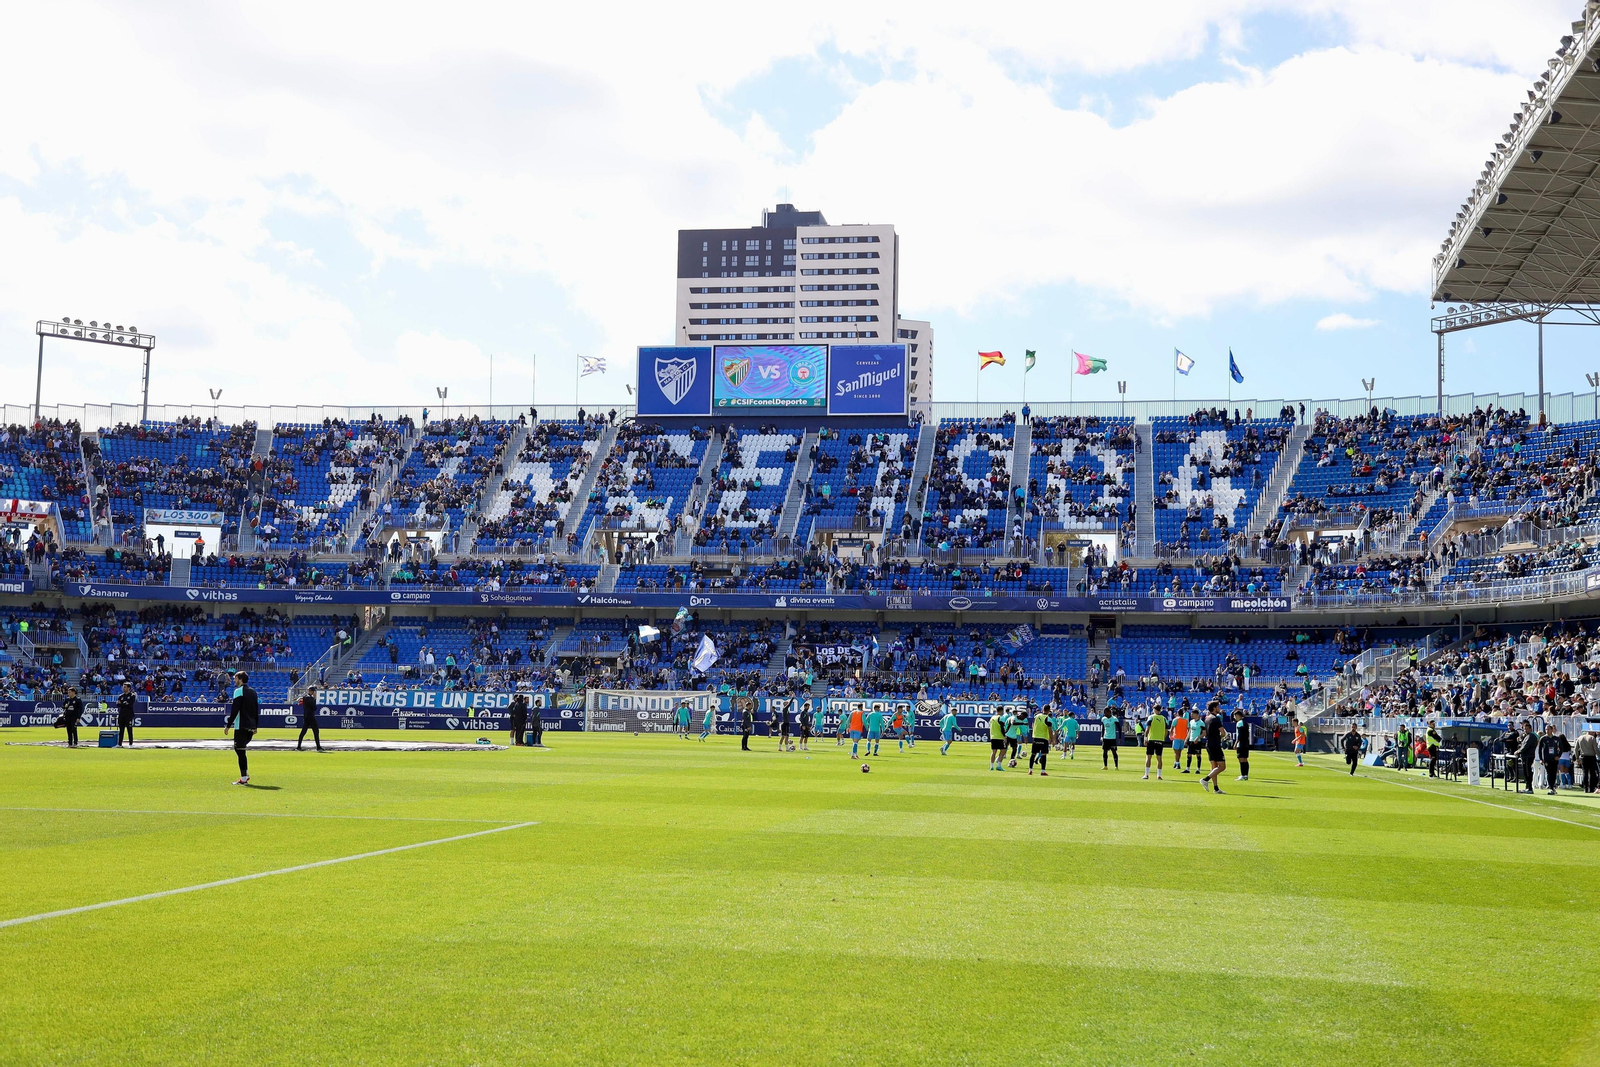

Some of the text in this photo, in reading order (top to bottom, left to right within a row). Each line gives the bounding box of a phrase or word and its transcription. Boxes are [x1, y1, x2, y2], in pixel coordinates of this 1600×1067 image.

[795, 361, 812, 369] IBIZA
[758, 365, 781, 379] VS
[730, 398, 808, 407] #CSIFconelDeporte
[163, 511, 209, 520] LOS 300
[90, 588, 129, 598] Sanamar
[202, 590, 238, 600] vithas
[590, 596, 618, 604] Halcón
[1178, 599, 1214, 608] campano
[1231, 597, 1287, 608] micolchón
[815, 646, 851, 656] LOS DE
[413, 692, 436, 708] DE
[441, 692, 467, 708] UN
[607, 695, 674, 711] FONDO
[462, 719, 500, 730] vithas
[590, 721, 626, 731] hummel
[953, 732, 988, 742] beebé
